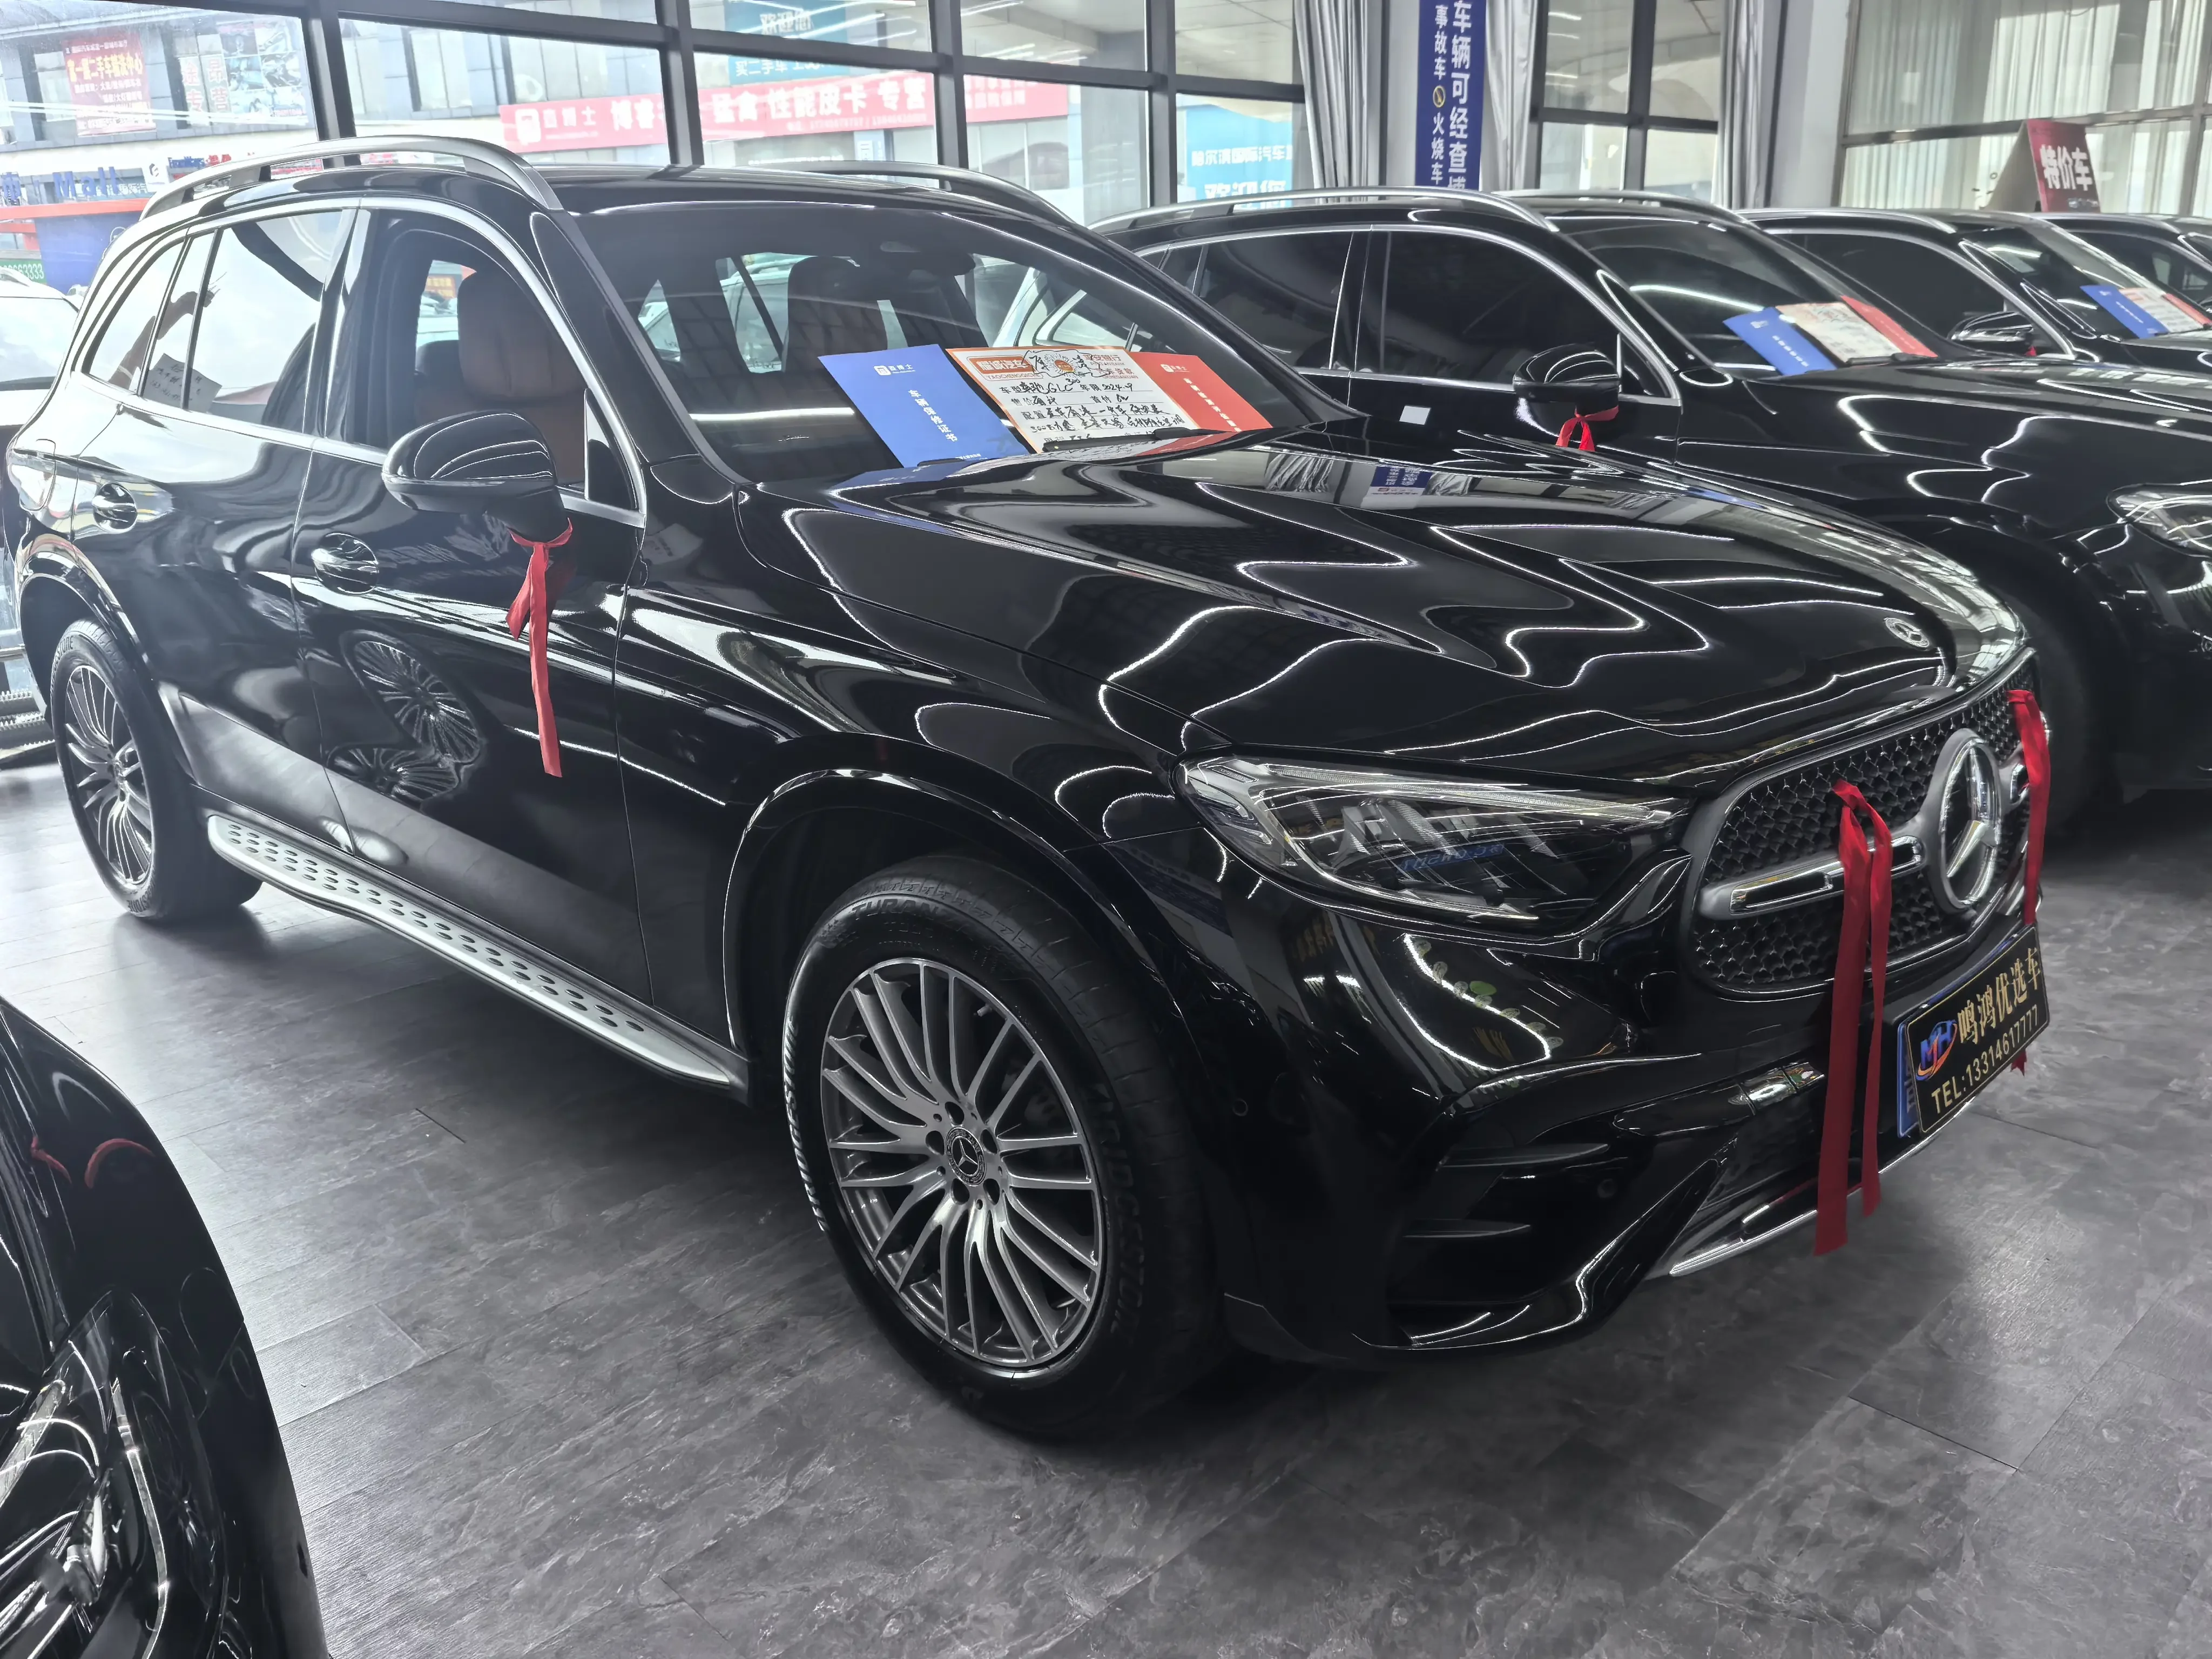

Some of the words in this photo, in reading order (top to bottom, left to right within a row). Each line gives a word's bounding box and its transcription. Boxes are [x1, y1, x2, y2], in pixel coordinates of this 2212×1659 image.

[1434, 4, 1448, 80] 事故车
[1431, 112, 1445, 185] 火烧车
[2040, 144, 2093, 191] 特价车
[52, 166, 120, 198] Mall
[908, 389, 957, 442] 车辆保修证书
[1021, 412, 1047, 420] 配置
[1957, 947, 2041, 1044] 鸣鸿优选车
